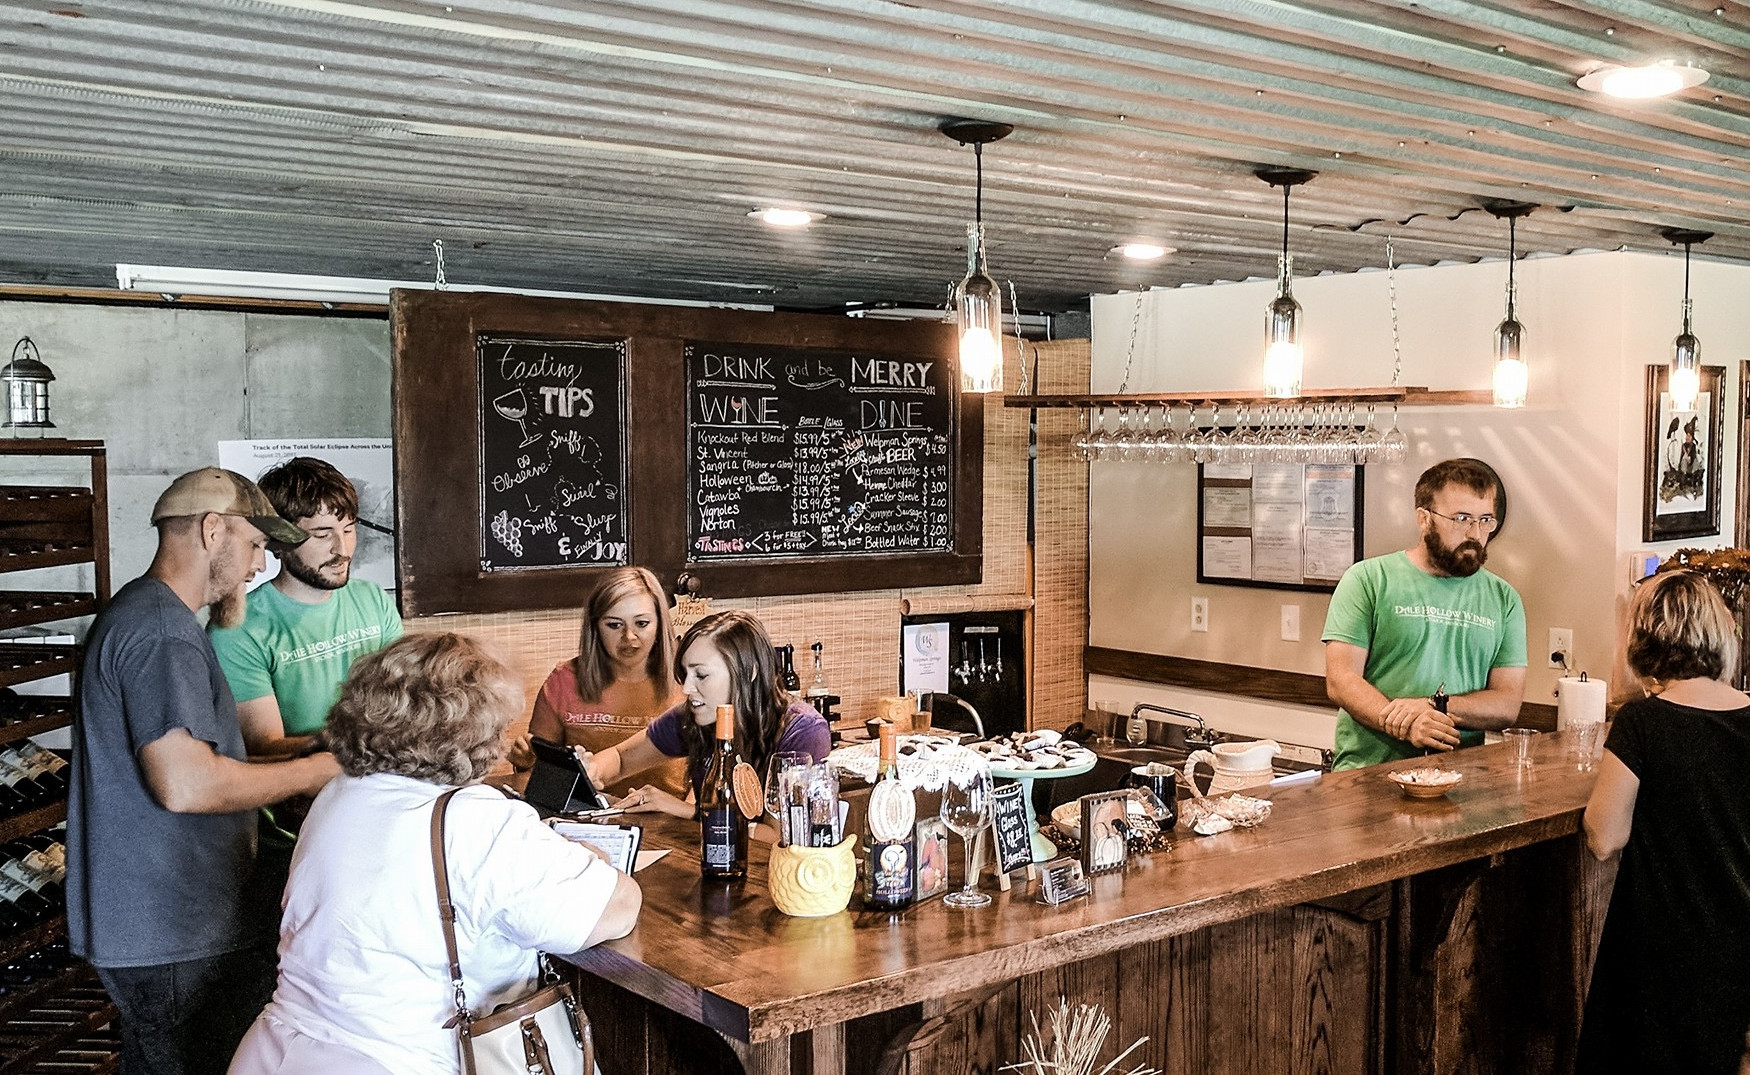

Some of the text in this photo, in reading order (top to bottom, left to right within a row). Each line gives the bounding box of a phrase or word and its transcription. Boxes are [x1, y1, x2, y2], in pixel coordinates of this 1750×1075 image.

[497, 345, 582, 390] tasting
[703, 354, 934, 388] DRINK and be MERRY
[539, 385, 594, 418] TIPS
[550, 429, 582, 455] Sniff
[697, 430, 785, 445] Knockout Red Blend
[843, 435, 864, 456] NEW
[901, 431, 928, 450] Springs
[272, 443, 279, 451] of
[327, 443, 349, 451] Eclipse
[696, 446, 749, 460] St. Vincent
[886, 448, 917, 464] BEER
[699, 460, 740, 475] Sangria
[896, 464, 921, 481] Wedge
[490, 462, 549, 493] Observe
[887, 476, 918, 490] Cheddar
[561, 483, 597, 507] Swirl
[697, 489, 741, 506] Catawba
[864, 491, 920, 505] Cracker Sleeve
[699, 503, 740, 522] Vignoles
[863, 504, 921, 522] Summer Sausage
[522, 515, 559, 537] Sniff
[573, 513, 617, 536] Slurp
[700, 516, 736, 533] Norton
[821, 524, 840, 533] NEW
[864, 520, 920, 534] Beef Snack Stix
[763, 531, 771, 541] 3
[772, 530, 784, 540] for
[864, 535, 896, 550] Bottled
[897, 534, 921, 547] Water
[557, 536, 572, 556] &
[698, 536, 745, 553] TASTINGS
[764, 543, 770, 552] 6
[772, 542, 782, 551] for
[1394, 605, 1420, 615] DALE
[1421, 605, 1461, 619] HOLLOW
[1462, 610, 1497, 629] WINERY
[280, 646, 307, 662] DALE
[306, 633, 347, 655] HOLLOW
[593, 713, 642, 725] HOLLOW
[1000, 797, 1018, 815] WINE
